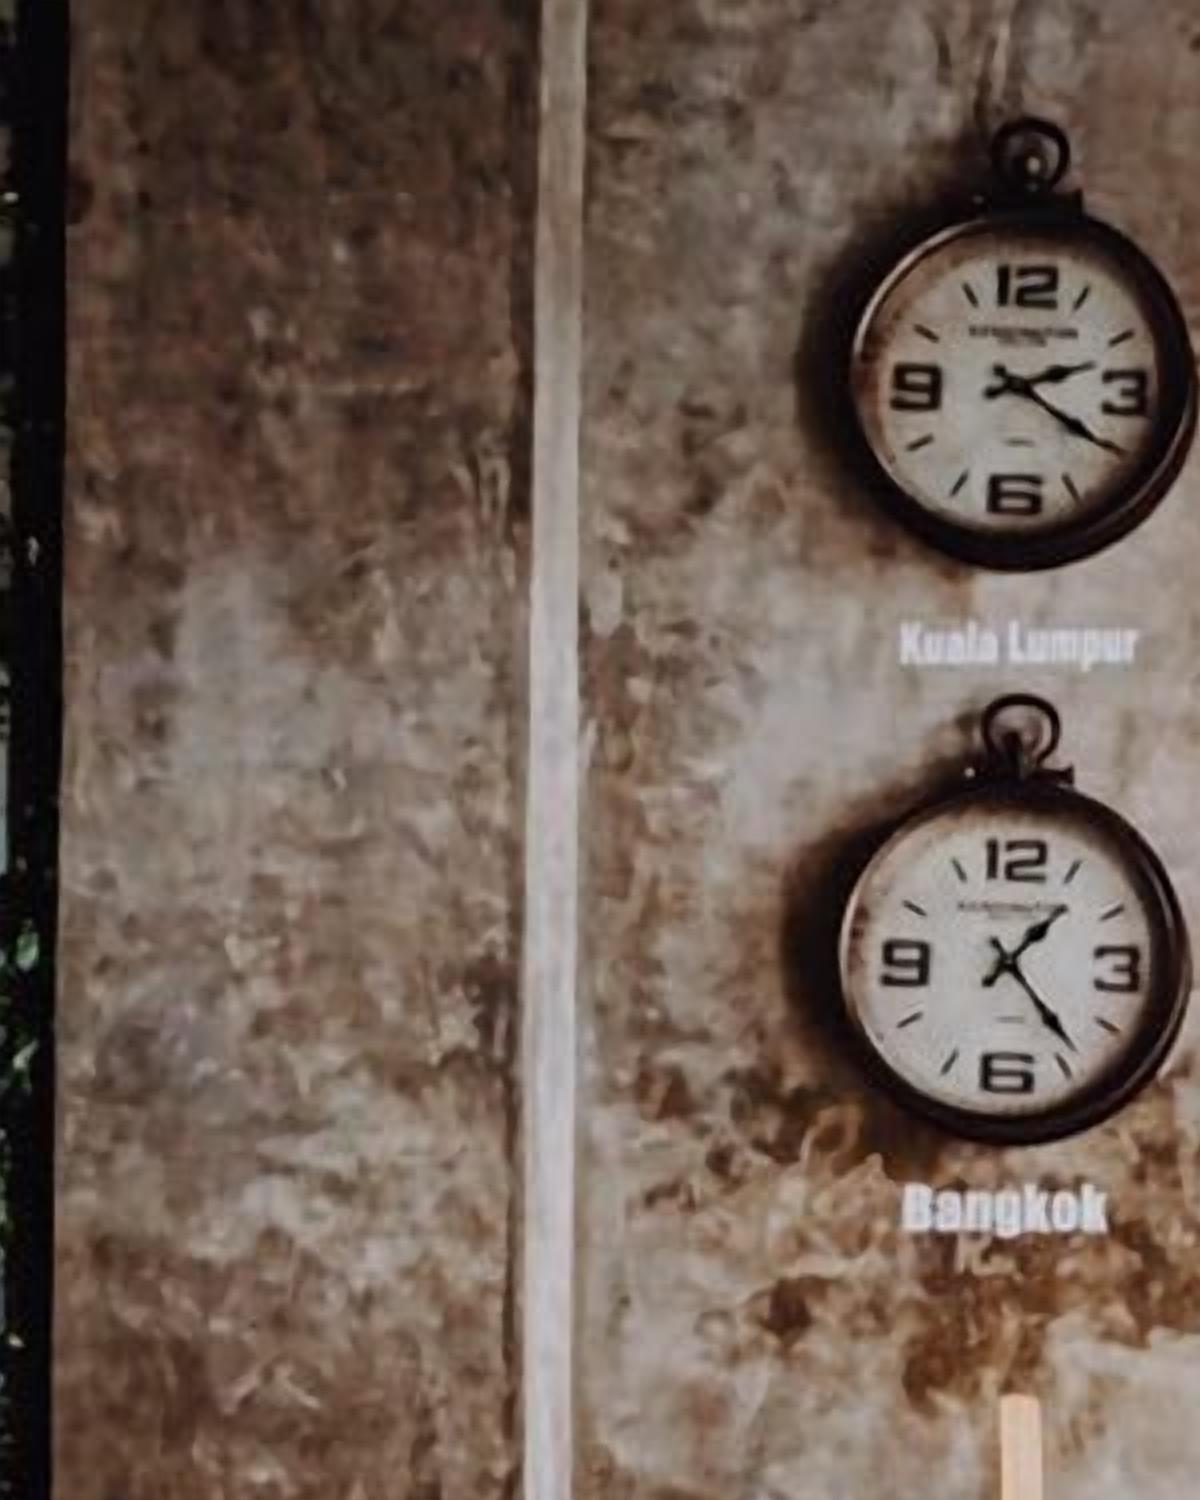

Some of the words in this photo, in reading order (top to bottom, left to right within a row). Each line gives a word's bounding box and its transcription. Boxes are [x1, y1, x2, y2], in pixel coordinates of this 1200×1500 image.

[997, 265, 1058, 309] 12
[889, 363, 942, 411] 9
[1101, 370, 1148, 417] 3
[986, 474, 1042, 515] 6
[899, 621, 999, 665] Kuala
[1008, 620, 1139, 672] Lumpur
[985, 839, 1047, 883] 12
[880, 940, 931, 988] 9
[1094, 945, 1140, 993] 3
[979, 1051, 1034, 1094] 6
[902, 1183, 1110, 1239] Bangkok
